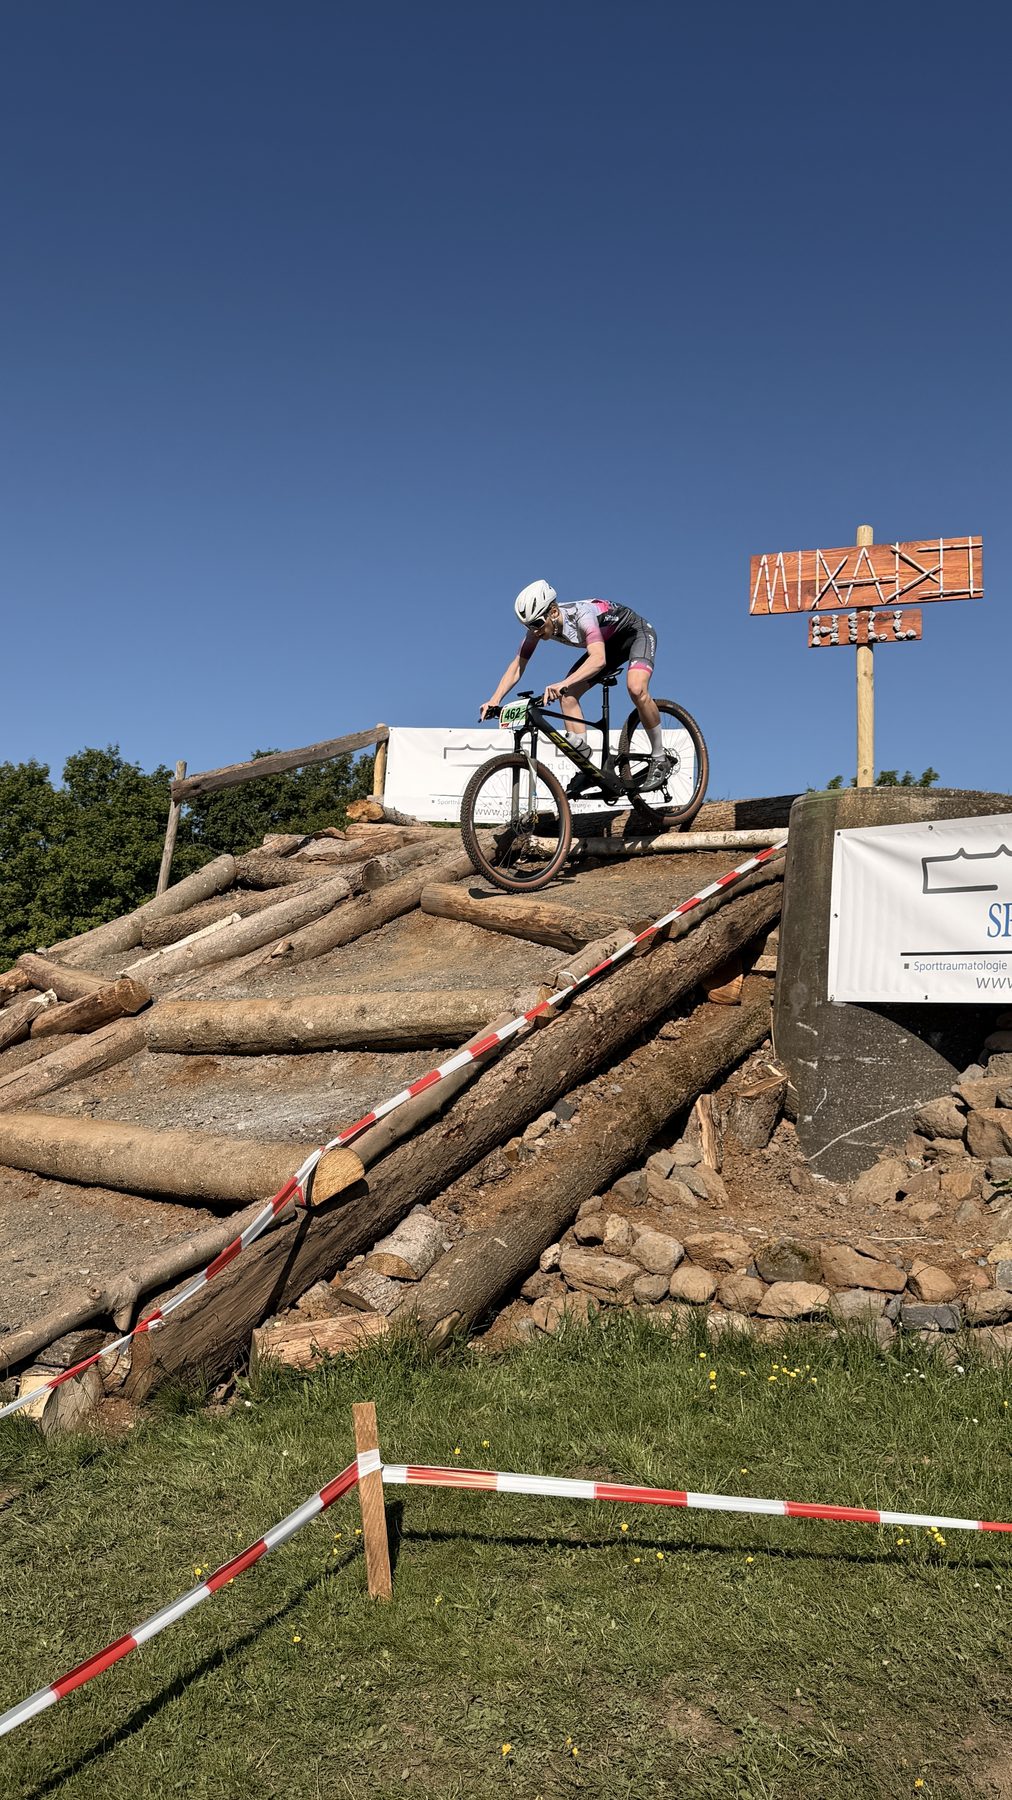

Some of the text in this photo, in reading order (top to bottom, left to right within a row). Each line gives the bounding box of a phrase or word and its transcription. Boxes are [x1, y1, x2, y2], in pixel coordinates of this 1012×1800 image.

[811, 610, 917, 646] HILL
[504, 707, 522, 720] 462
[913, 959, 1008, 973] Sporttraumatologie
